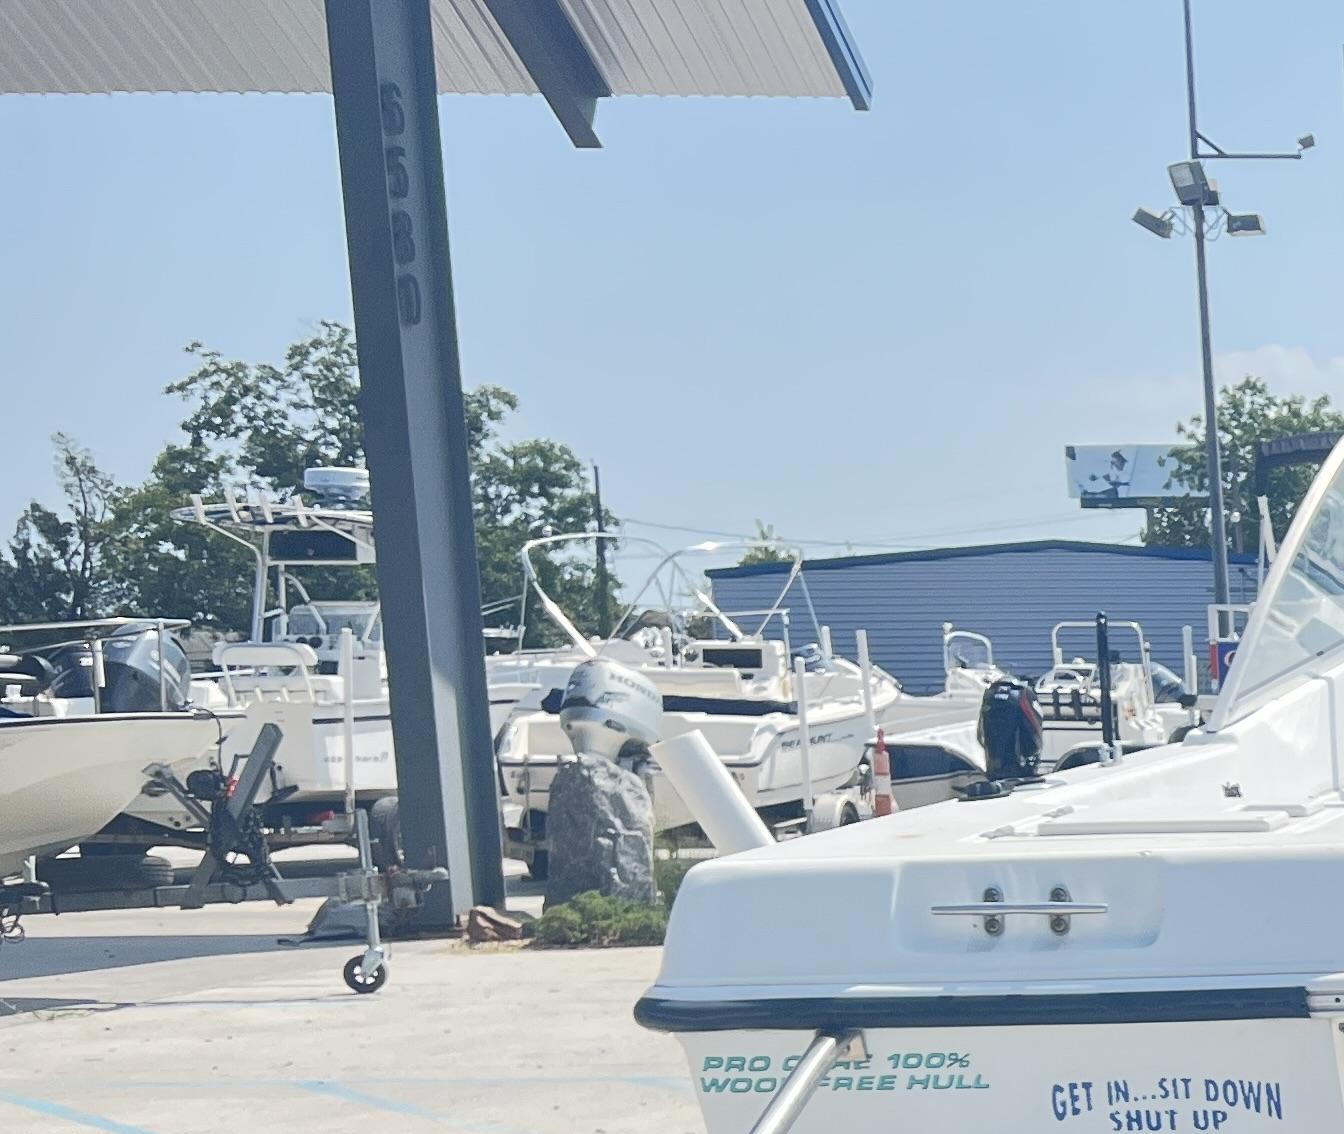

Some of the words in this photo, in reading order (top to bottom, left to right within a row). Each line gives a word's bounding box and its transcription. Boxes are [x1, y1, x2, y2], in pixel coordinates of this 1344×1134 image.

[702, 1056, 771, 1071] PRO
[782, 1055, 872, 1070] CRE
[887, 1052, 970, 1069] 100%
[700, 1077, 784, 1093] WOO
[906, 1073, 990, 1090] HULL
[1052, 1082, 1093, 1121] GET
[1204, 1079, 1283, 1120] DOWN
[1109, 1109, 1178, 1131] SHUT
[1193, 1110, 1228, 1130] UP
